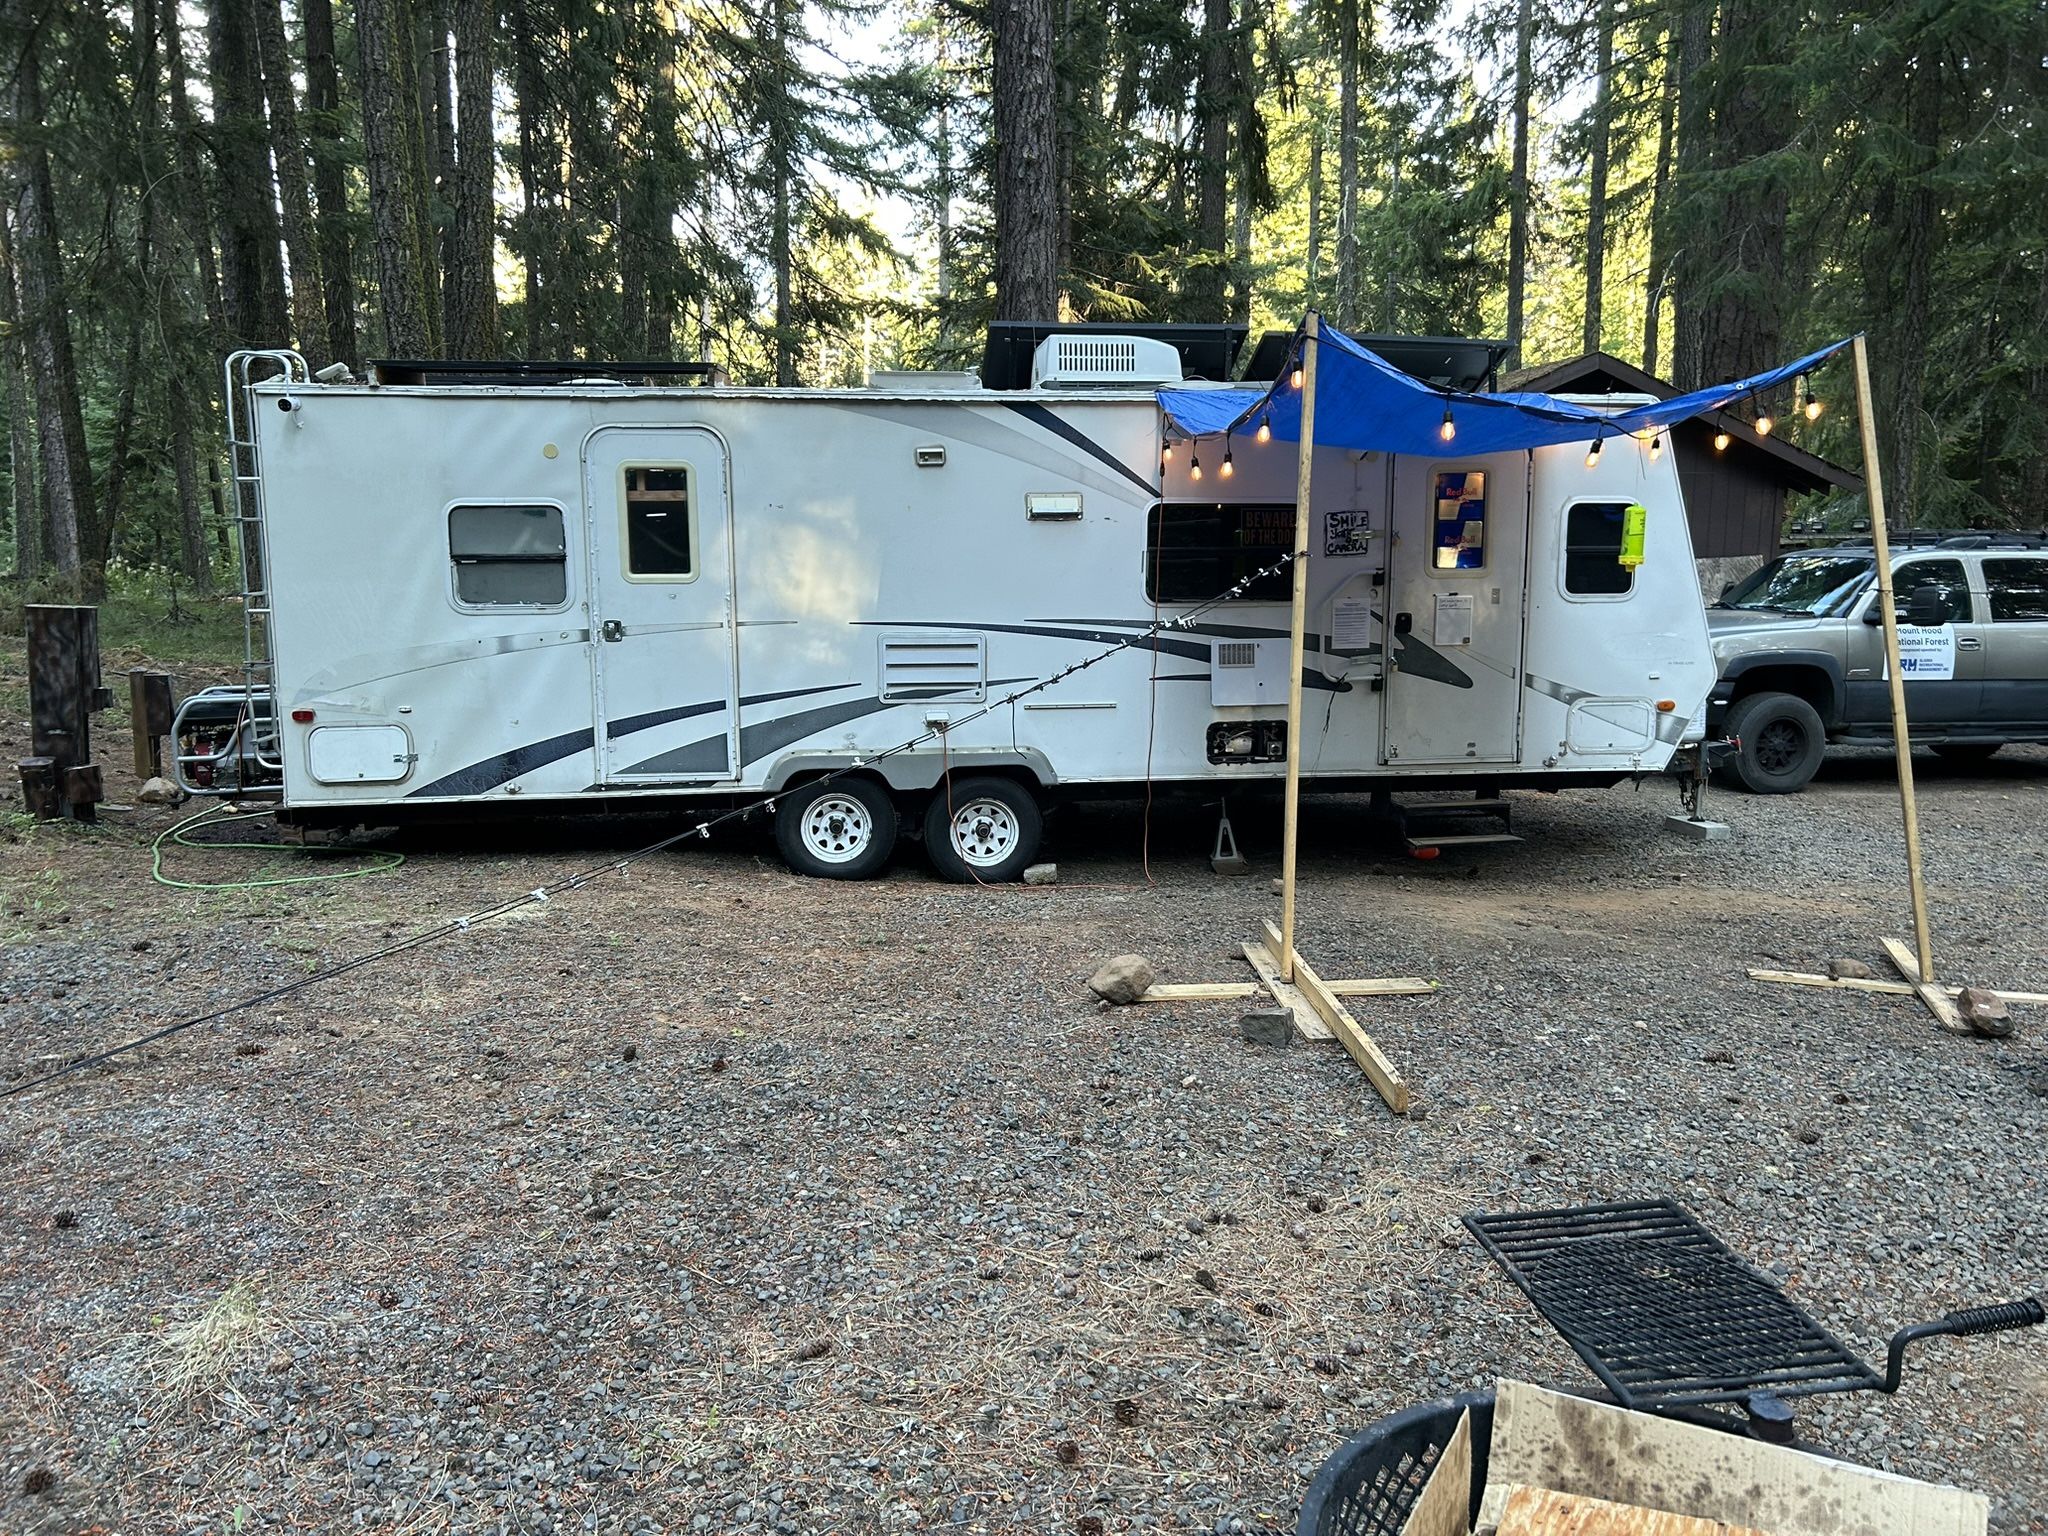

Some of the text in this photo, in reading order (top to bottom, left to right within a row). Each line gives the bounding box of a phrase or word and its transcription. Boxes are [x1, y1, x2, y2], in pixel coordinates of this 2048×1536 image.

[1246, 511, 1296, 527] BEWARE
[1244, 529, 1256, 544] OF
[1258, 529, 1276, 544] THE
[1897, 638, 1949, 646] ational Forest
